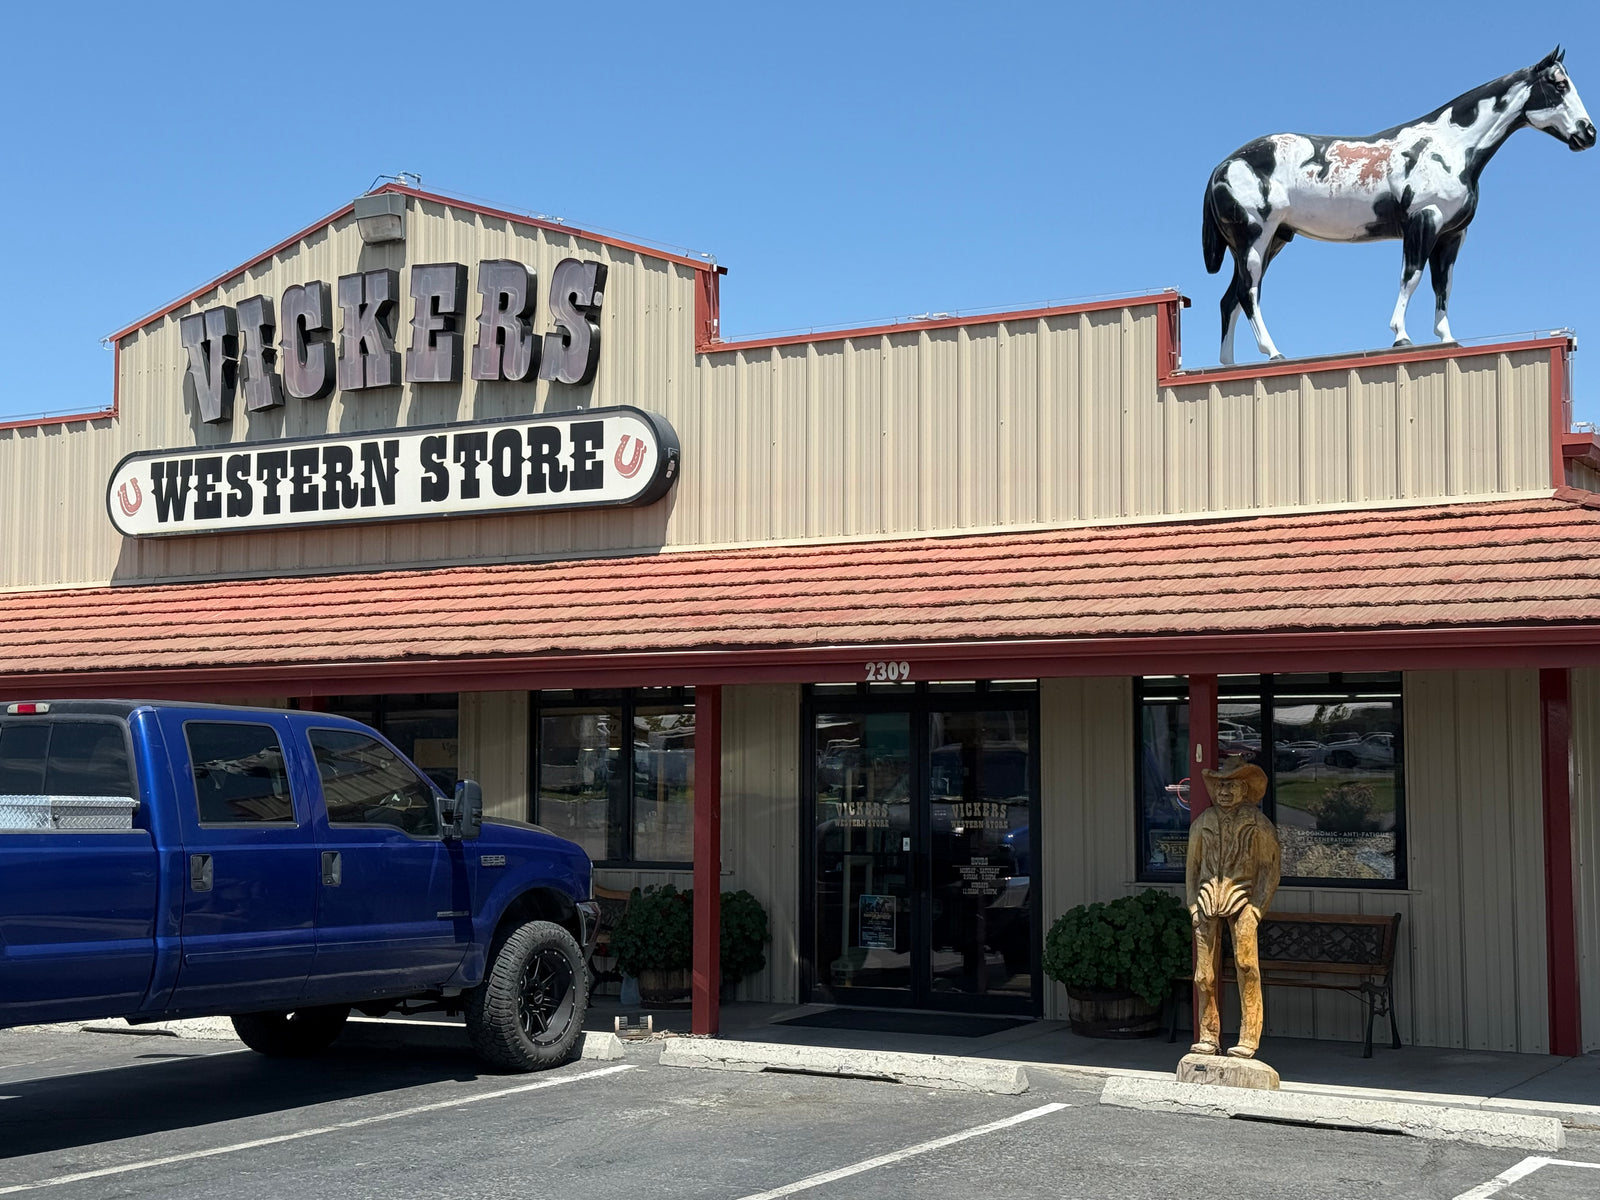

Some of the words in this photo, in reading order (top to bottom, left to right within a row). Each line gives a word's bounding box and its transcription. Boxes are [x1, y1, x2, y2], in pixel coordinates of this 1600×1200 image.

[180, 258, 607, 424] VICKERS
[150, 440, 400, 523] WESTERN
[420, 420, 604, 503] STORE
[865, 661, 910, 681] 2309
[837, 802, 889, 818] VICKERS
[951, 802, 1007, 819] VICKERS
[835, 818, 866, 828] WESTERN
[868, 818, 889, 828] STORE
[951, 820, 983, 829] WESTERN
[985, 820, 1008, 829] STORE
